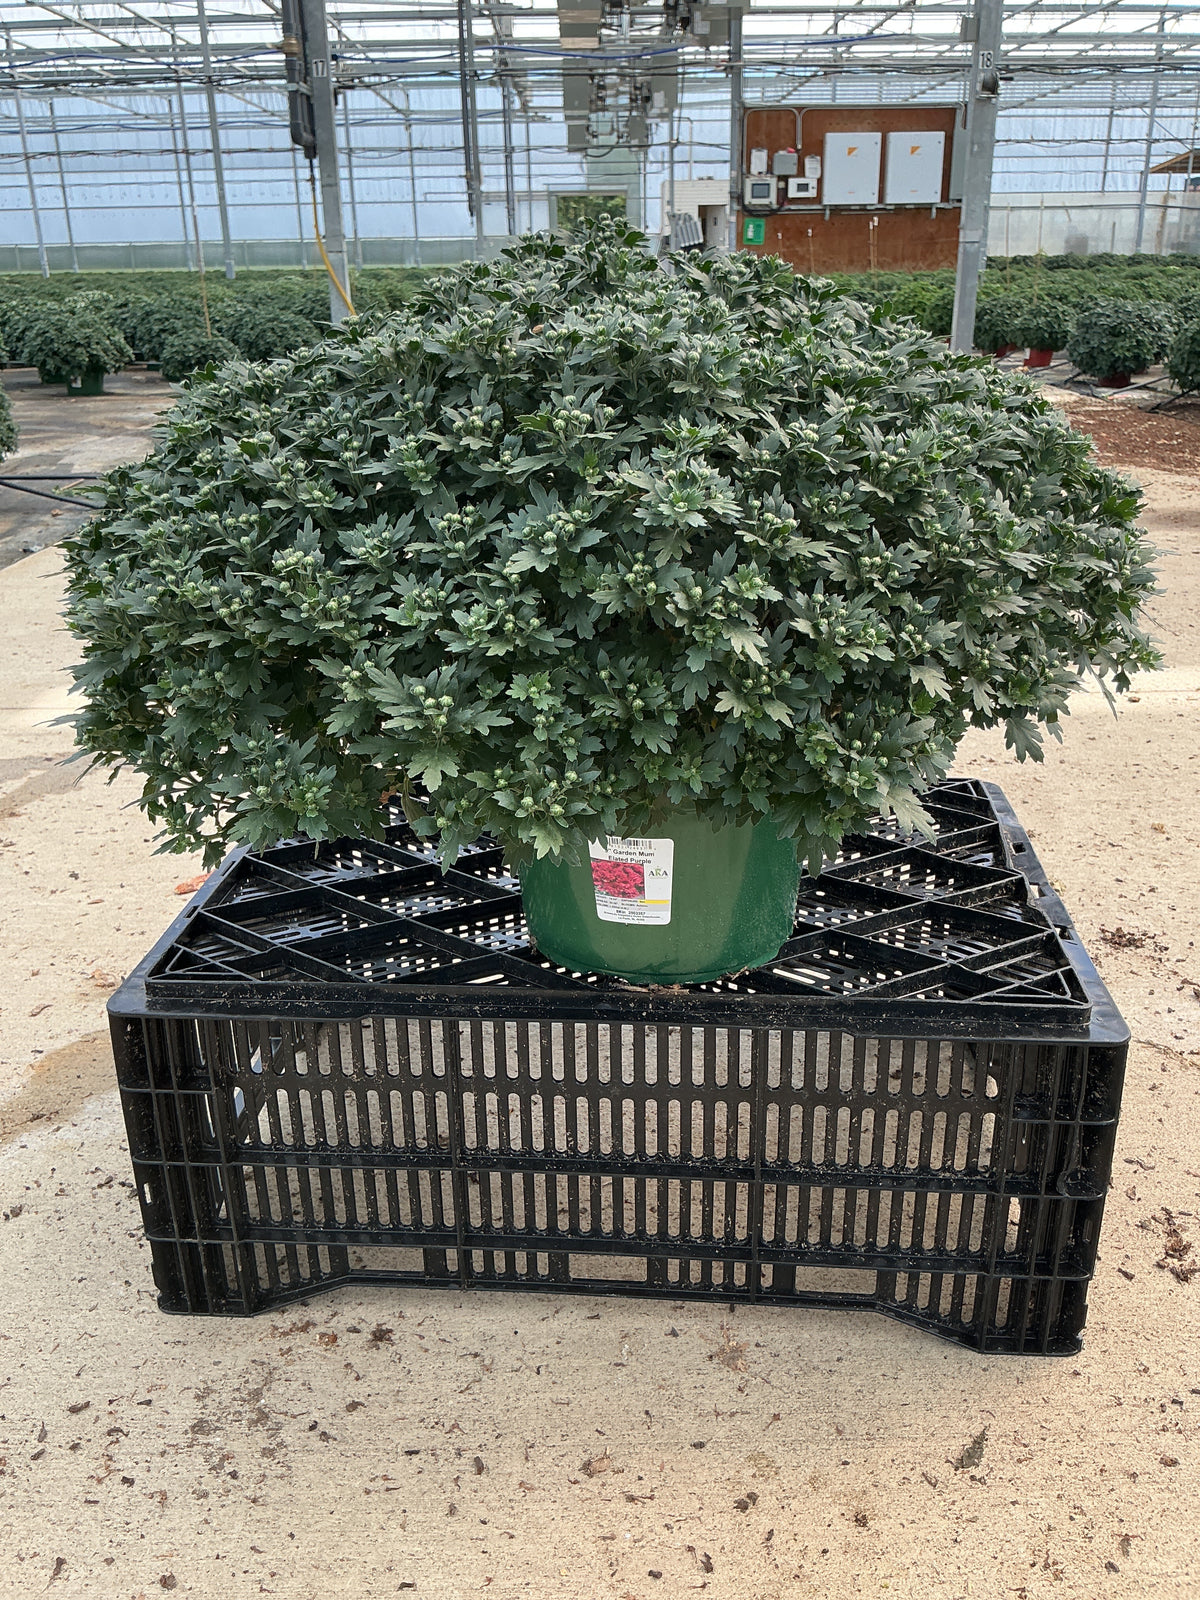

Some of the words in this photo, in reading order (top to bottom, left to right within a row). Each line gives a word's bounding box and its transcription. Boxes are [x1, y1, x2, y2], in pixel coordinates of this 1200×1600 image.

[313, 60, 325, 76] 17
[981, 52, 992, 68] 18
[613, 848, 637, 856] Garden
